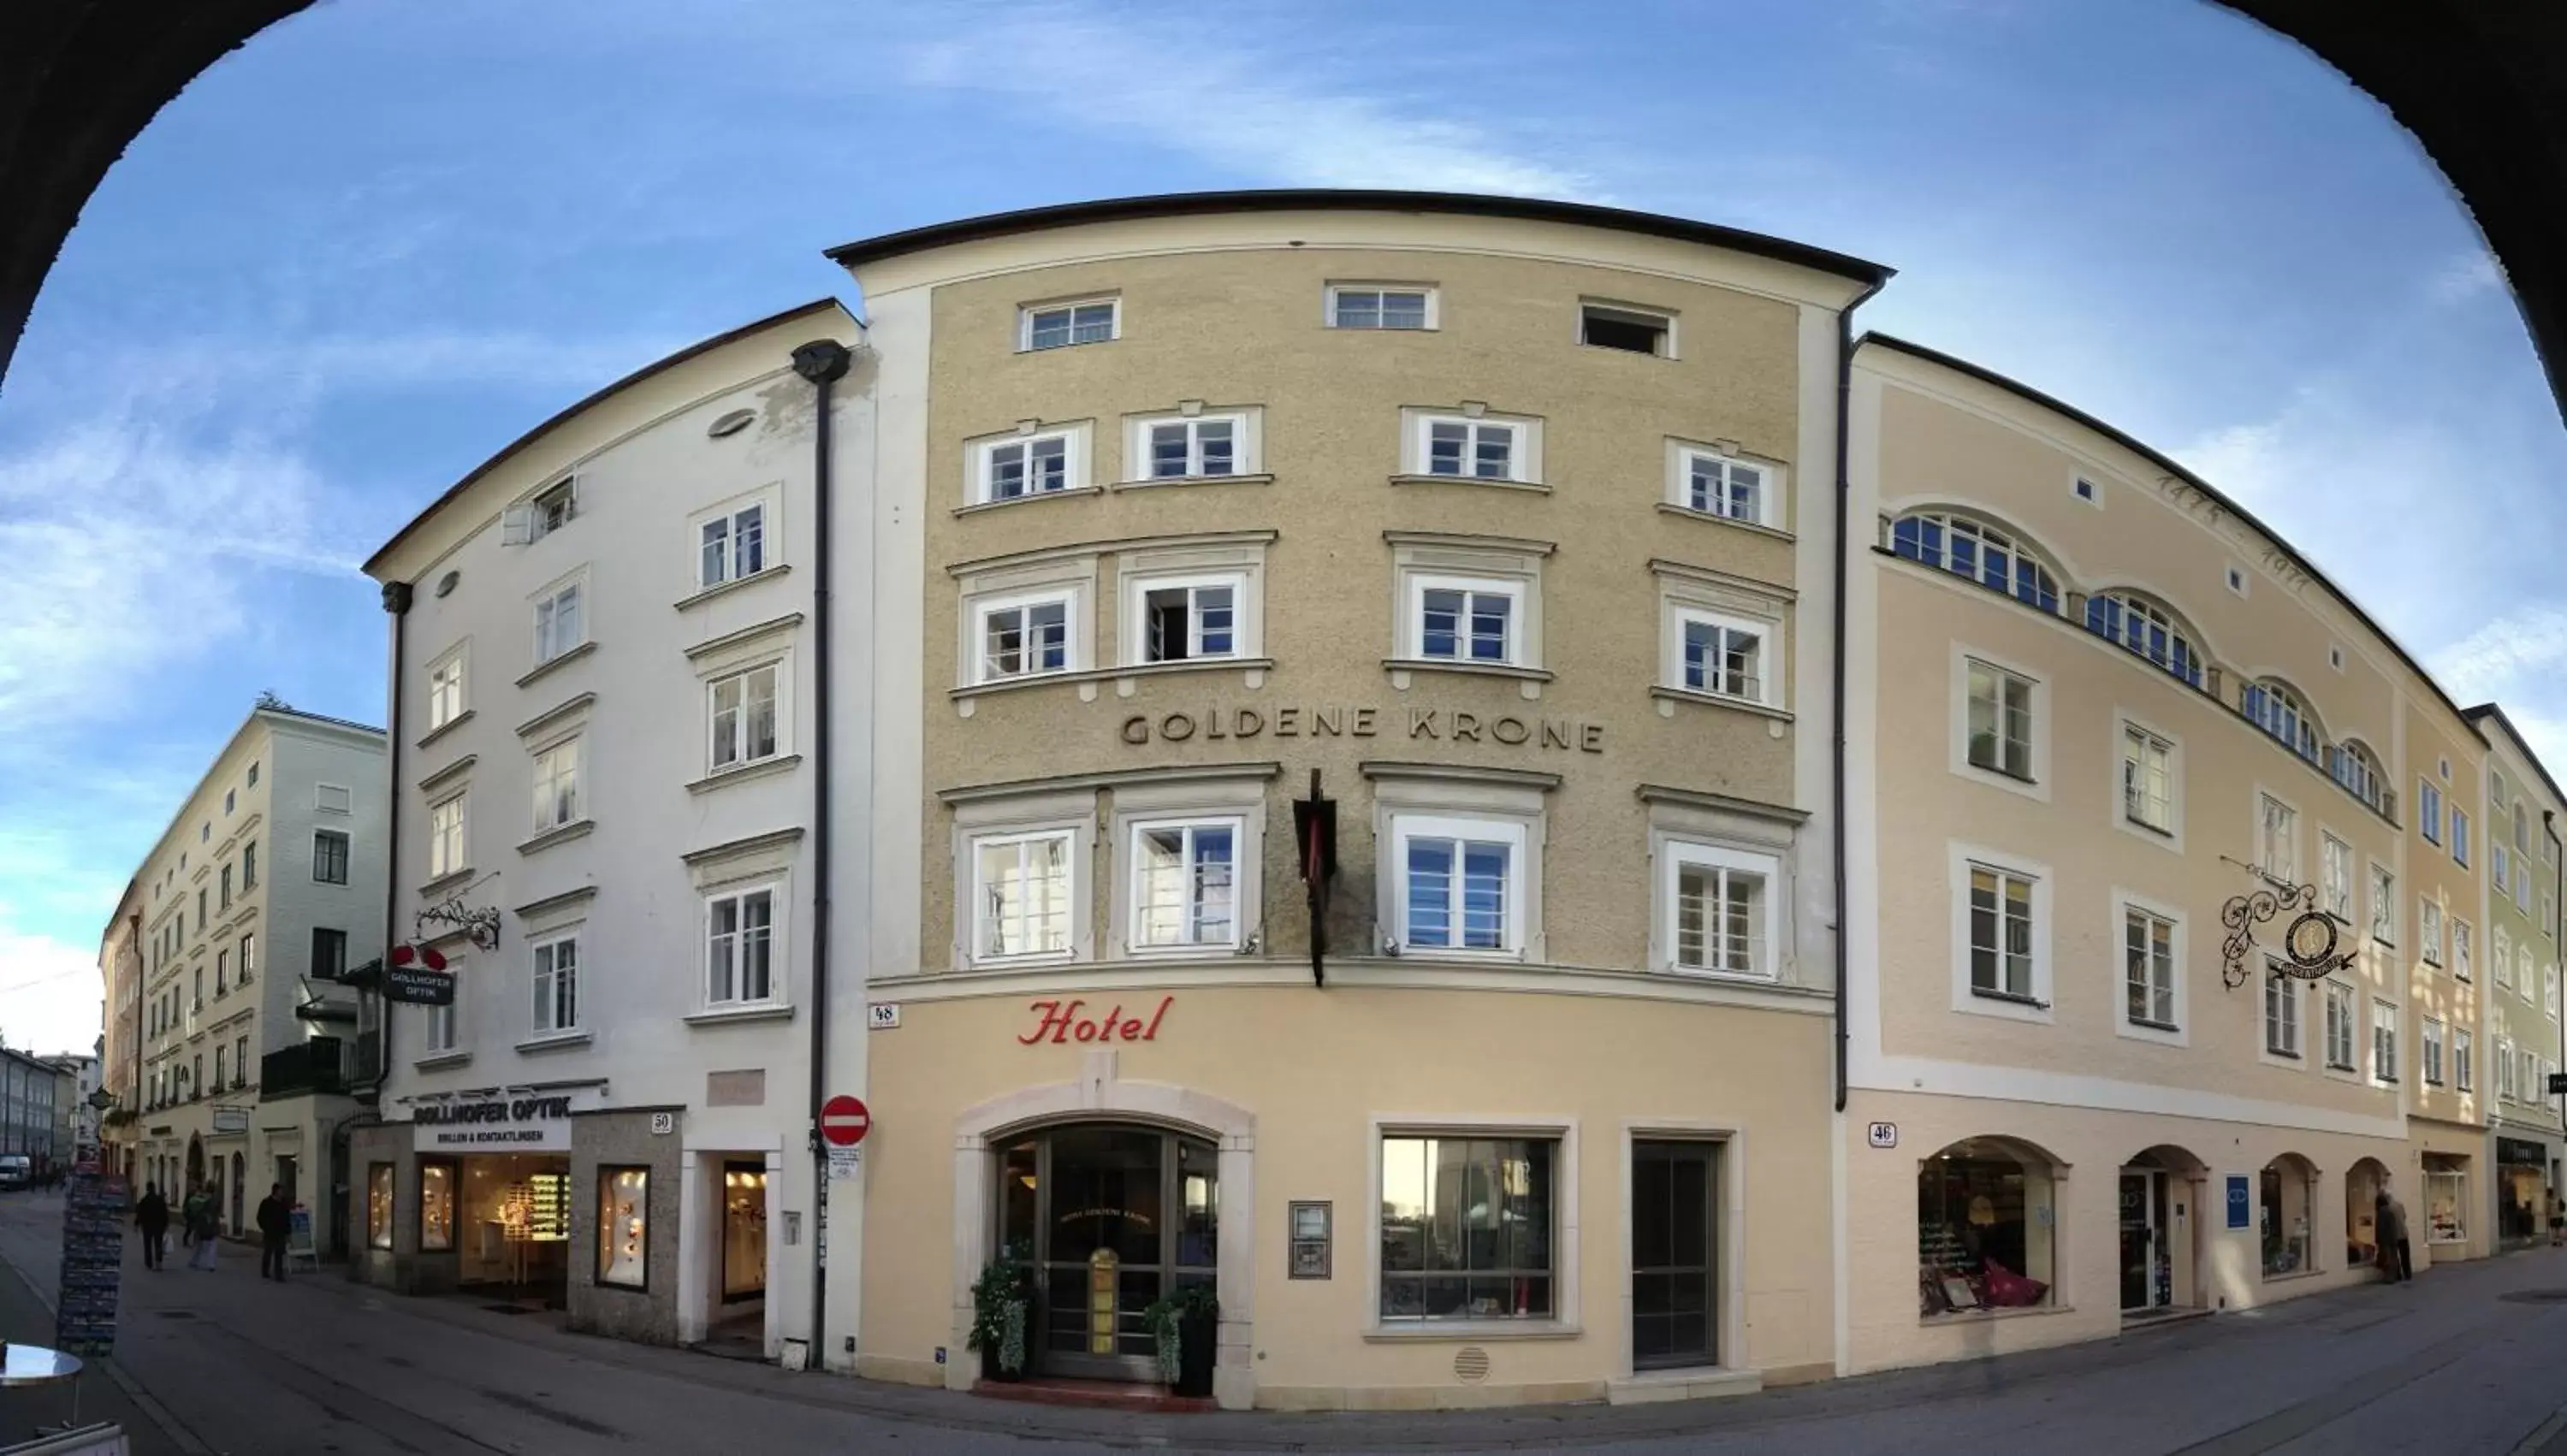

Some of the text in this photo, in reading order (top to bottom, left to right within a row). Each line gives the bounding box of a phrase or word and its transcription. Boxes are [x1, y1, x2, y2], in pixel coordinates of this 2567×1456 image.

[1120, 707, 1604, 755] GOLDENE KRONE
[406, 985, 436, 997] OPTIK
[875, 1006, 892, 1021] 48
[1017, 996, 1174, 1045] Hotel
[513, 1096, 572, 1122] OPTIK
[655, 1114, 668, 1129] 50
[1874, 1125, 1891, 1140] 46
